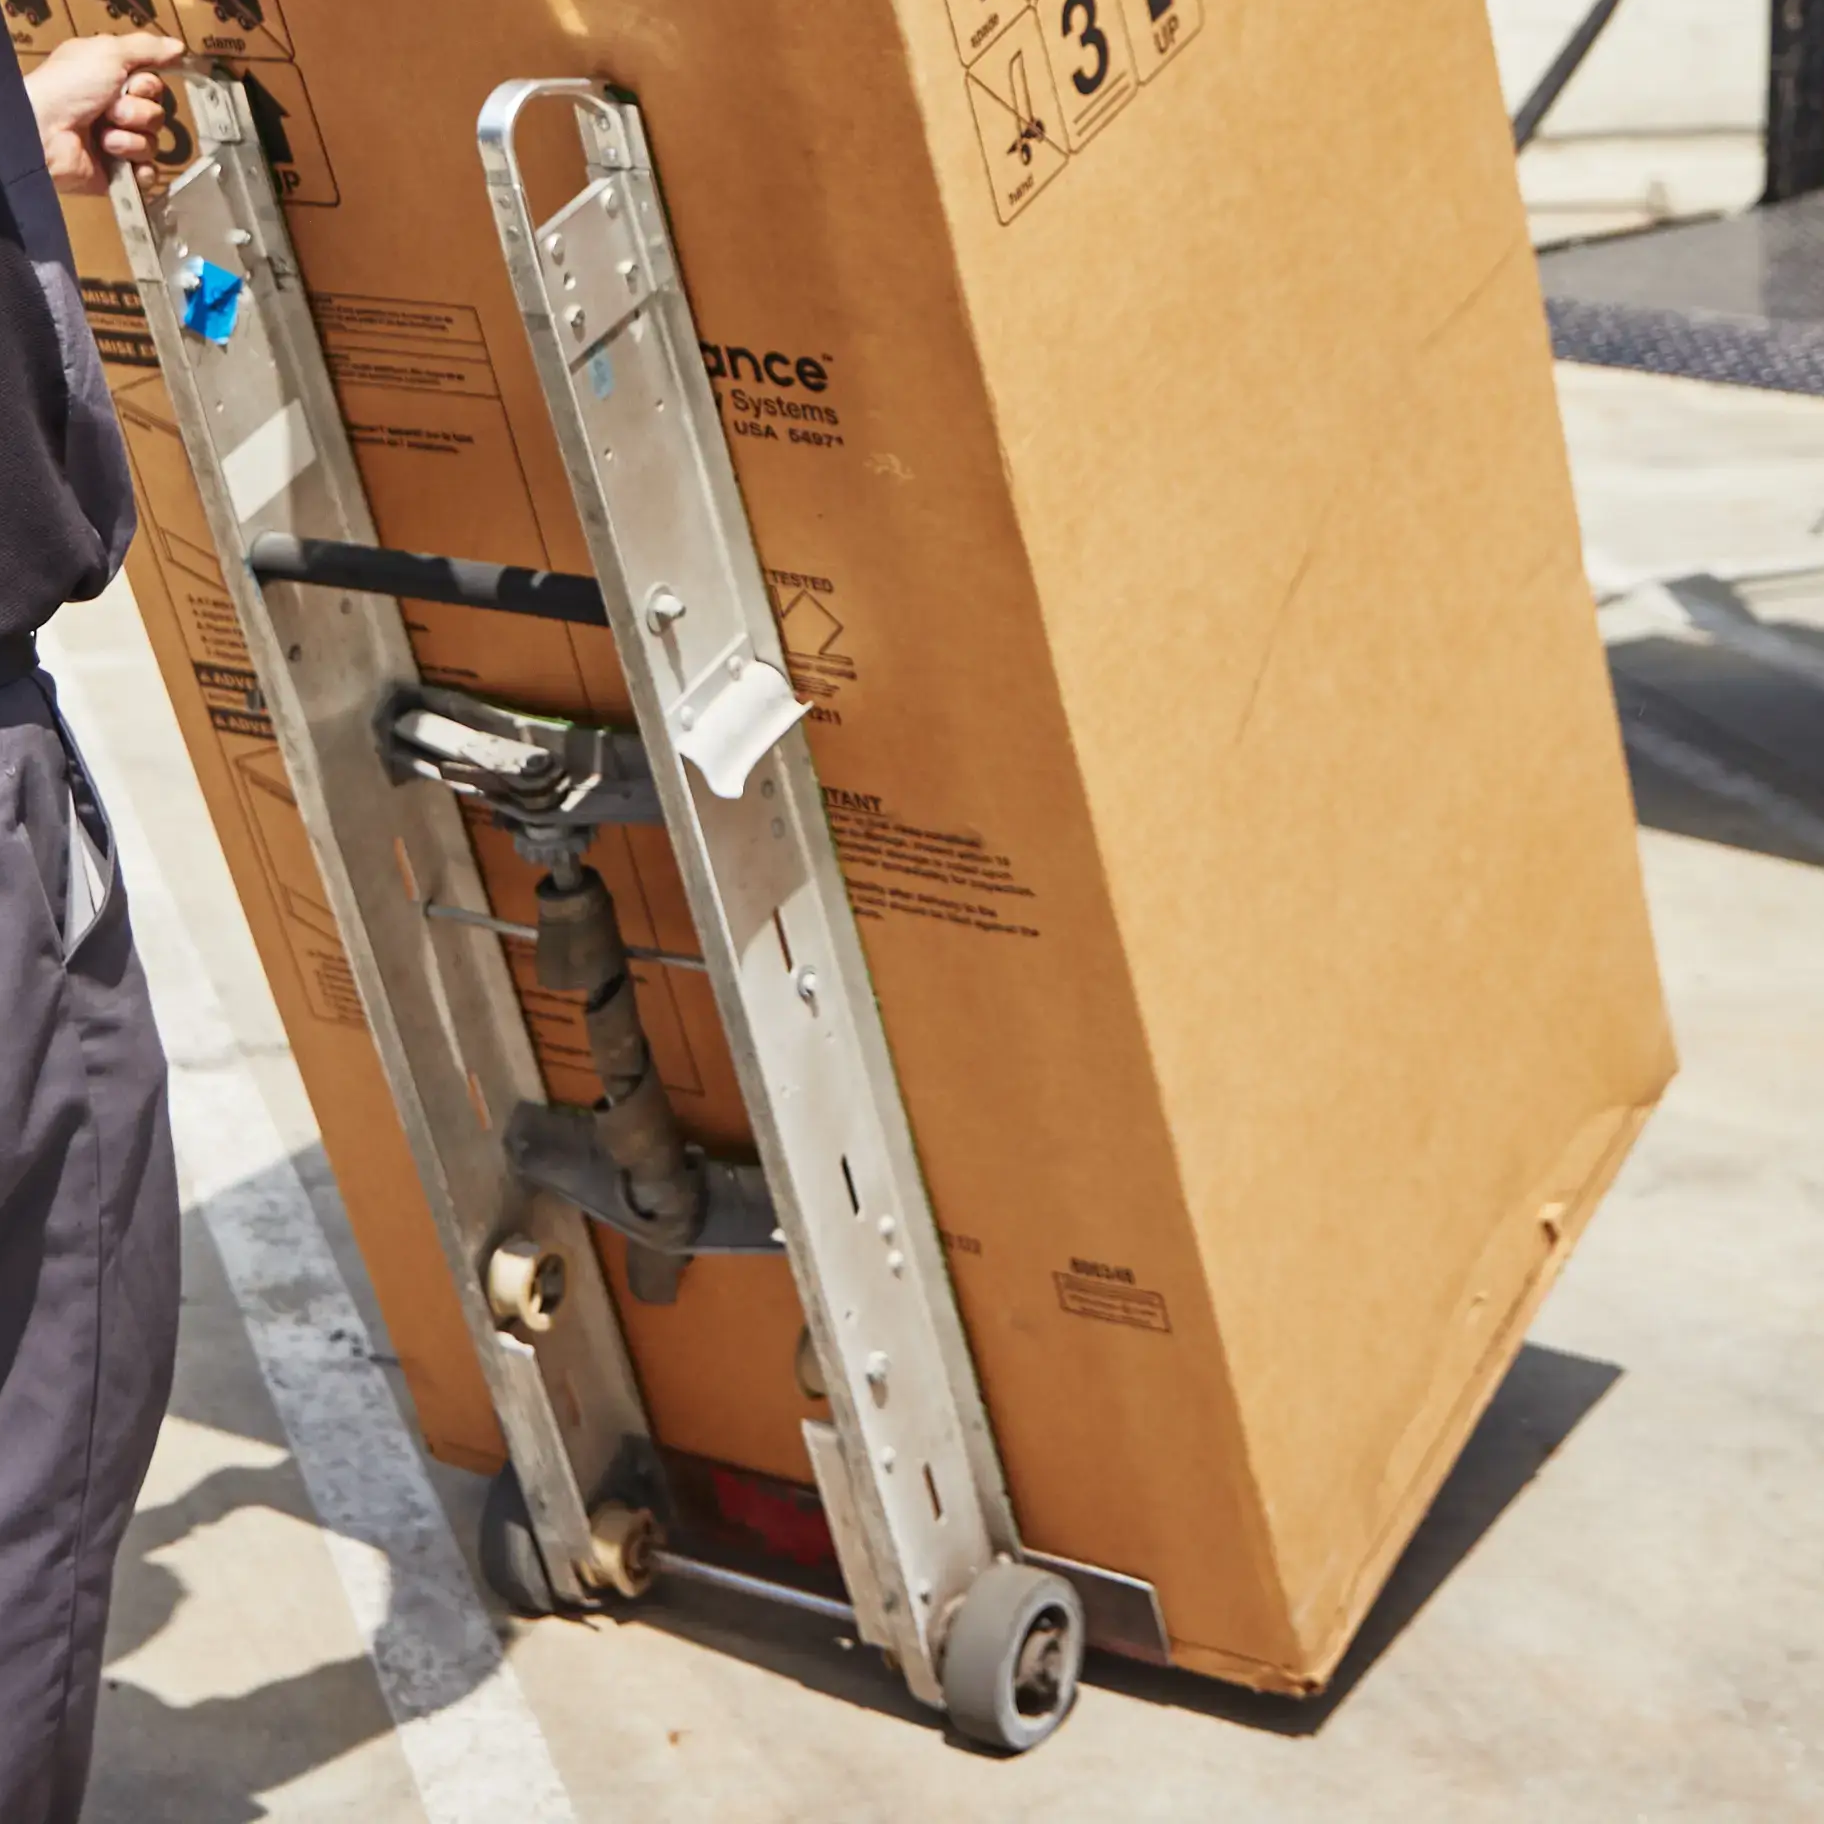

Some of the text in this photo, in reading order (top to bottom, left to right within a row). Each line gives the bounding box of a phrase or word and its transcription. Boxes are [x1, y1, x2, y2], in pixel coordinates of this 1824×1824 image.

[202, 34, 246, 54] clamp
[1152, 12, 1181, 56] UP
[731, 388, 839, 425] Systems
[733, 420, 779, 441] USA
